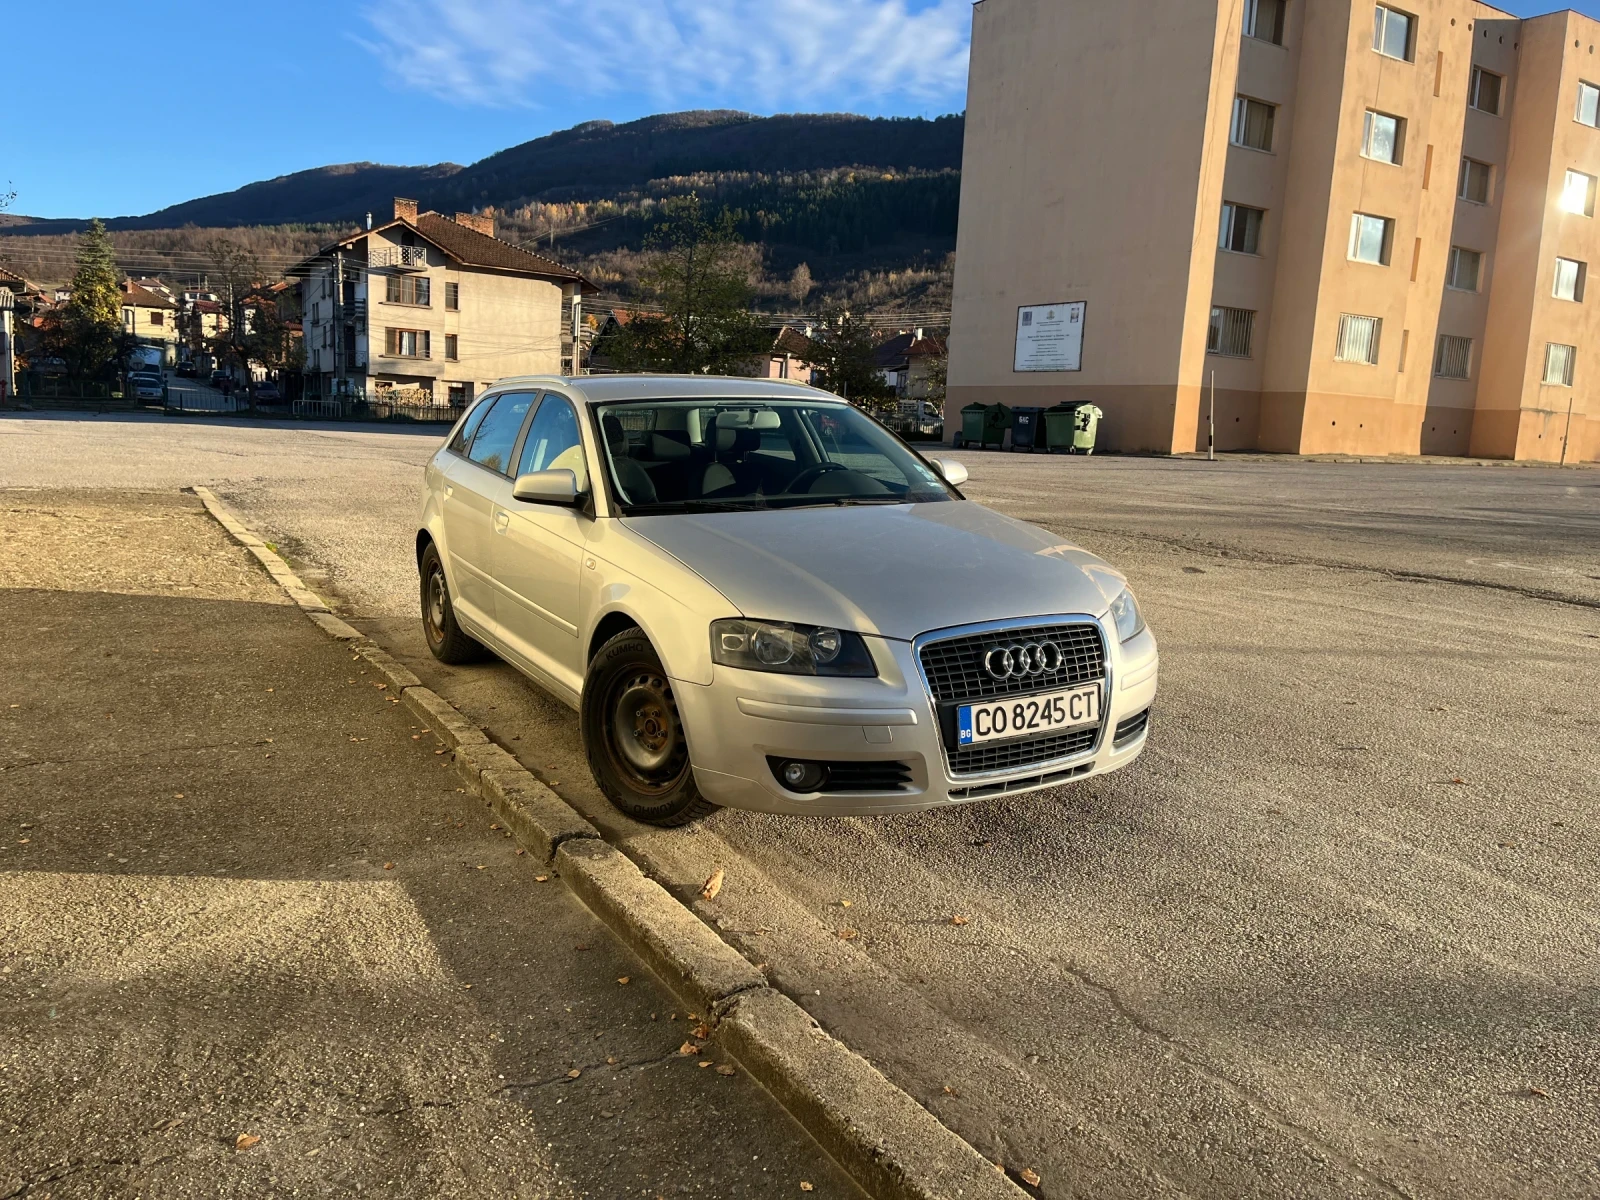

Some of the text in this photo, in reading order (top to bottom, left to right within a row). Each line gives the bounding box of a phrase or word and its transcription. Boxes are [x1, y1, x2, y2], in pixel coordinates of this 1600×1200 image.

[605, 642, 644, 661] KUMHO
[1012, 696, 1066, 730] 8245
[1069, 691, 1095, 720] CT
[960, 729, 971, 738] BG
[633, 801, 675, 815] KUMHO
